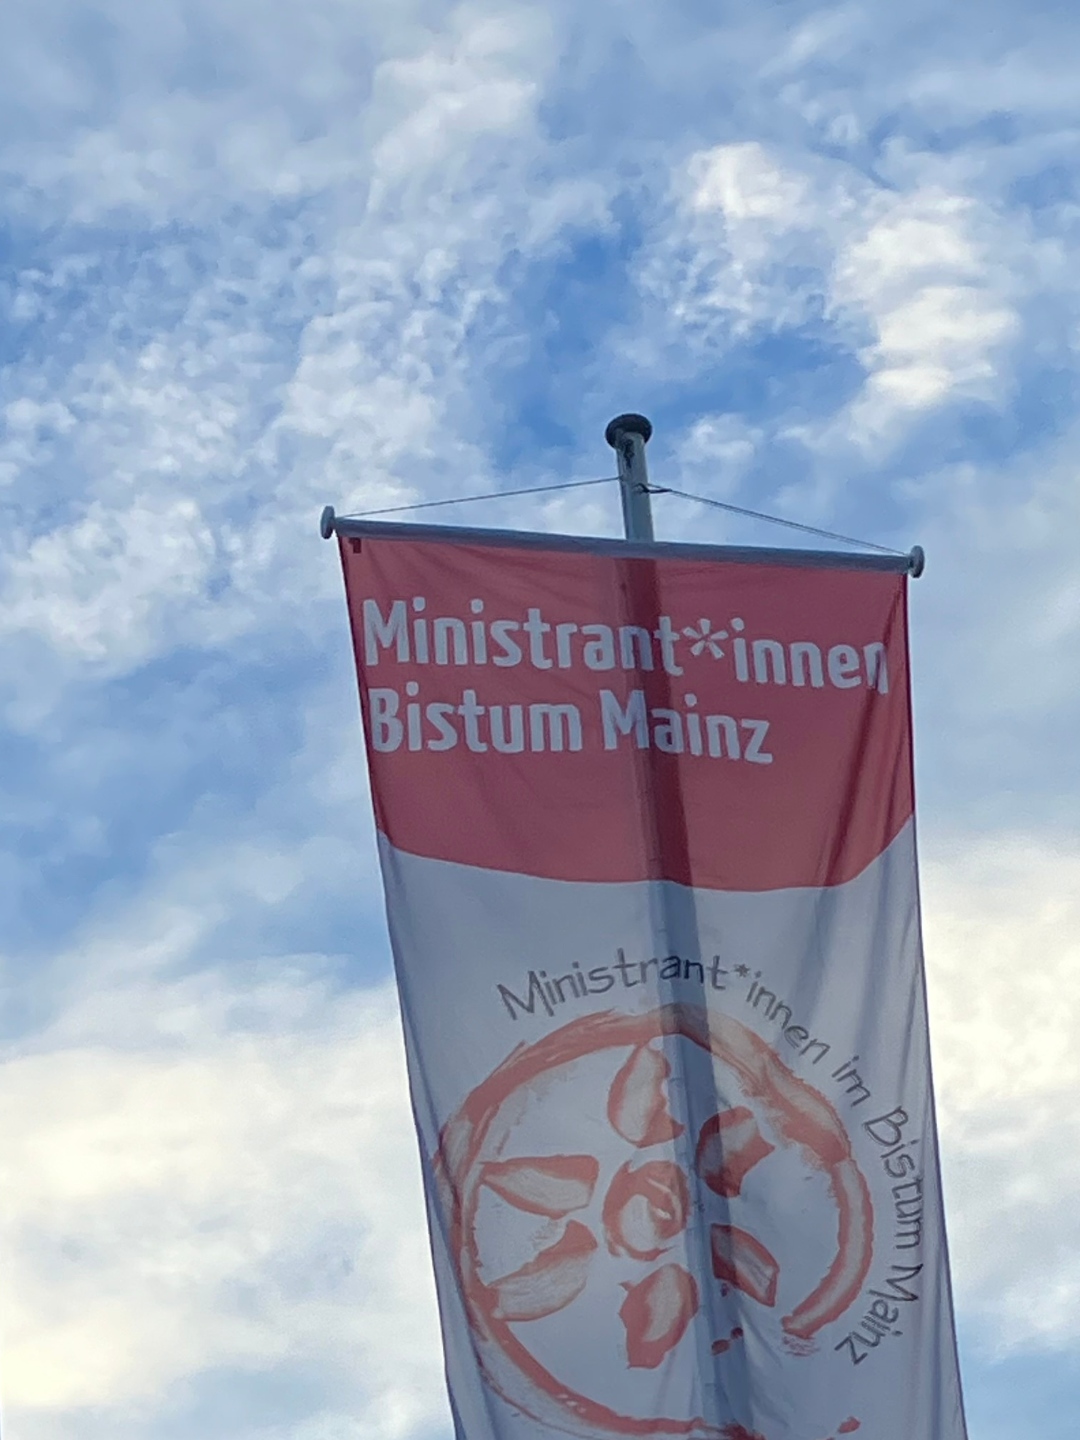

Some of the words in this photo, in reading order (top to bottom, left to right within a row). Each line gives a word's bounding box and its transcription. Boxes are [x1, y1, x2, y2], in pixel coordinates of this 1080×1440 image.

[369, 683, 583, 753] Bistum
[600, 690, 774, 763] Mainz
[831, 1055, 871, 1106] im
[863, 1106, 924, 1250] Bistum
[834, 1263, 924, 1365] Mainz
